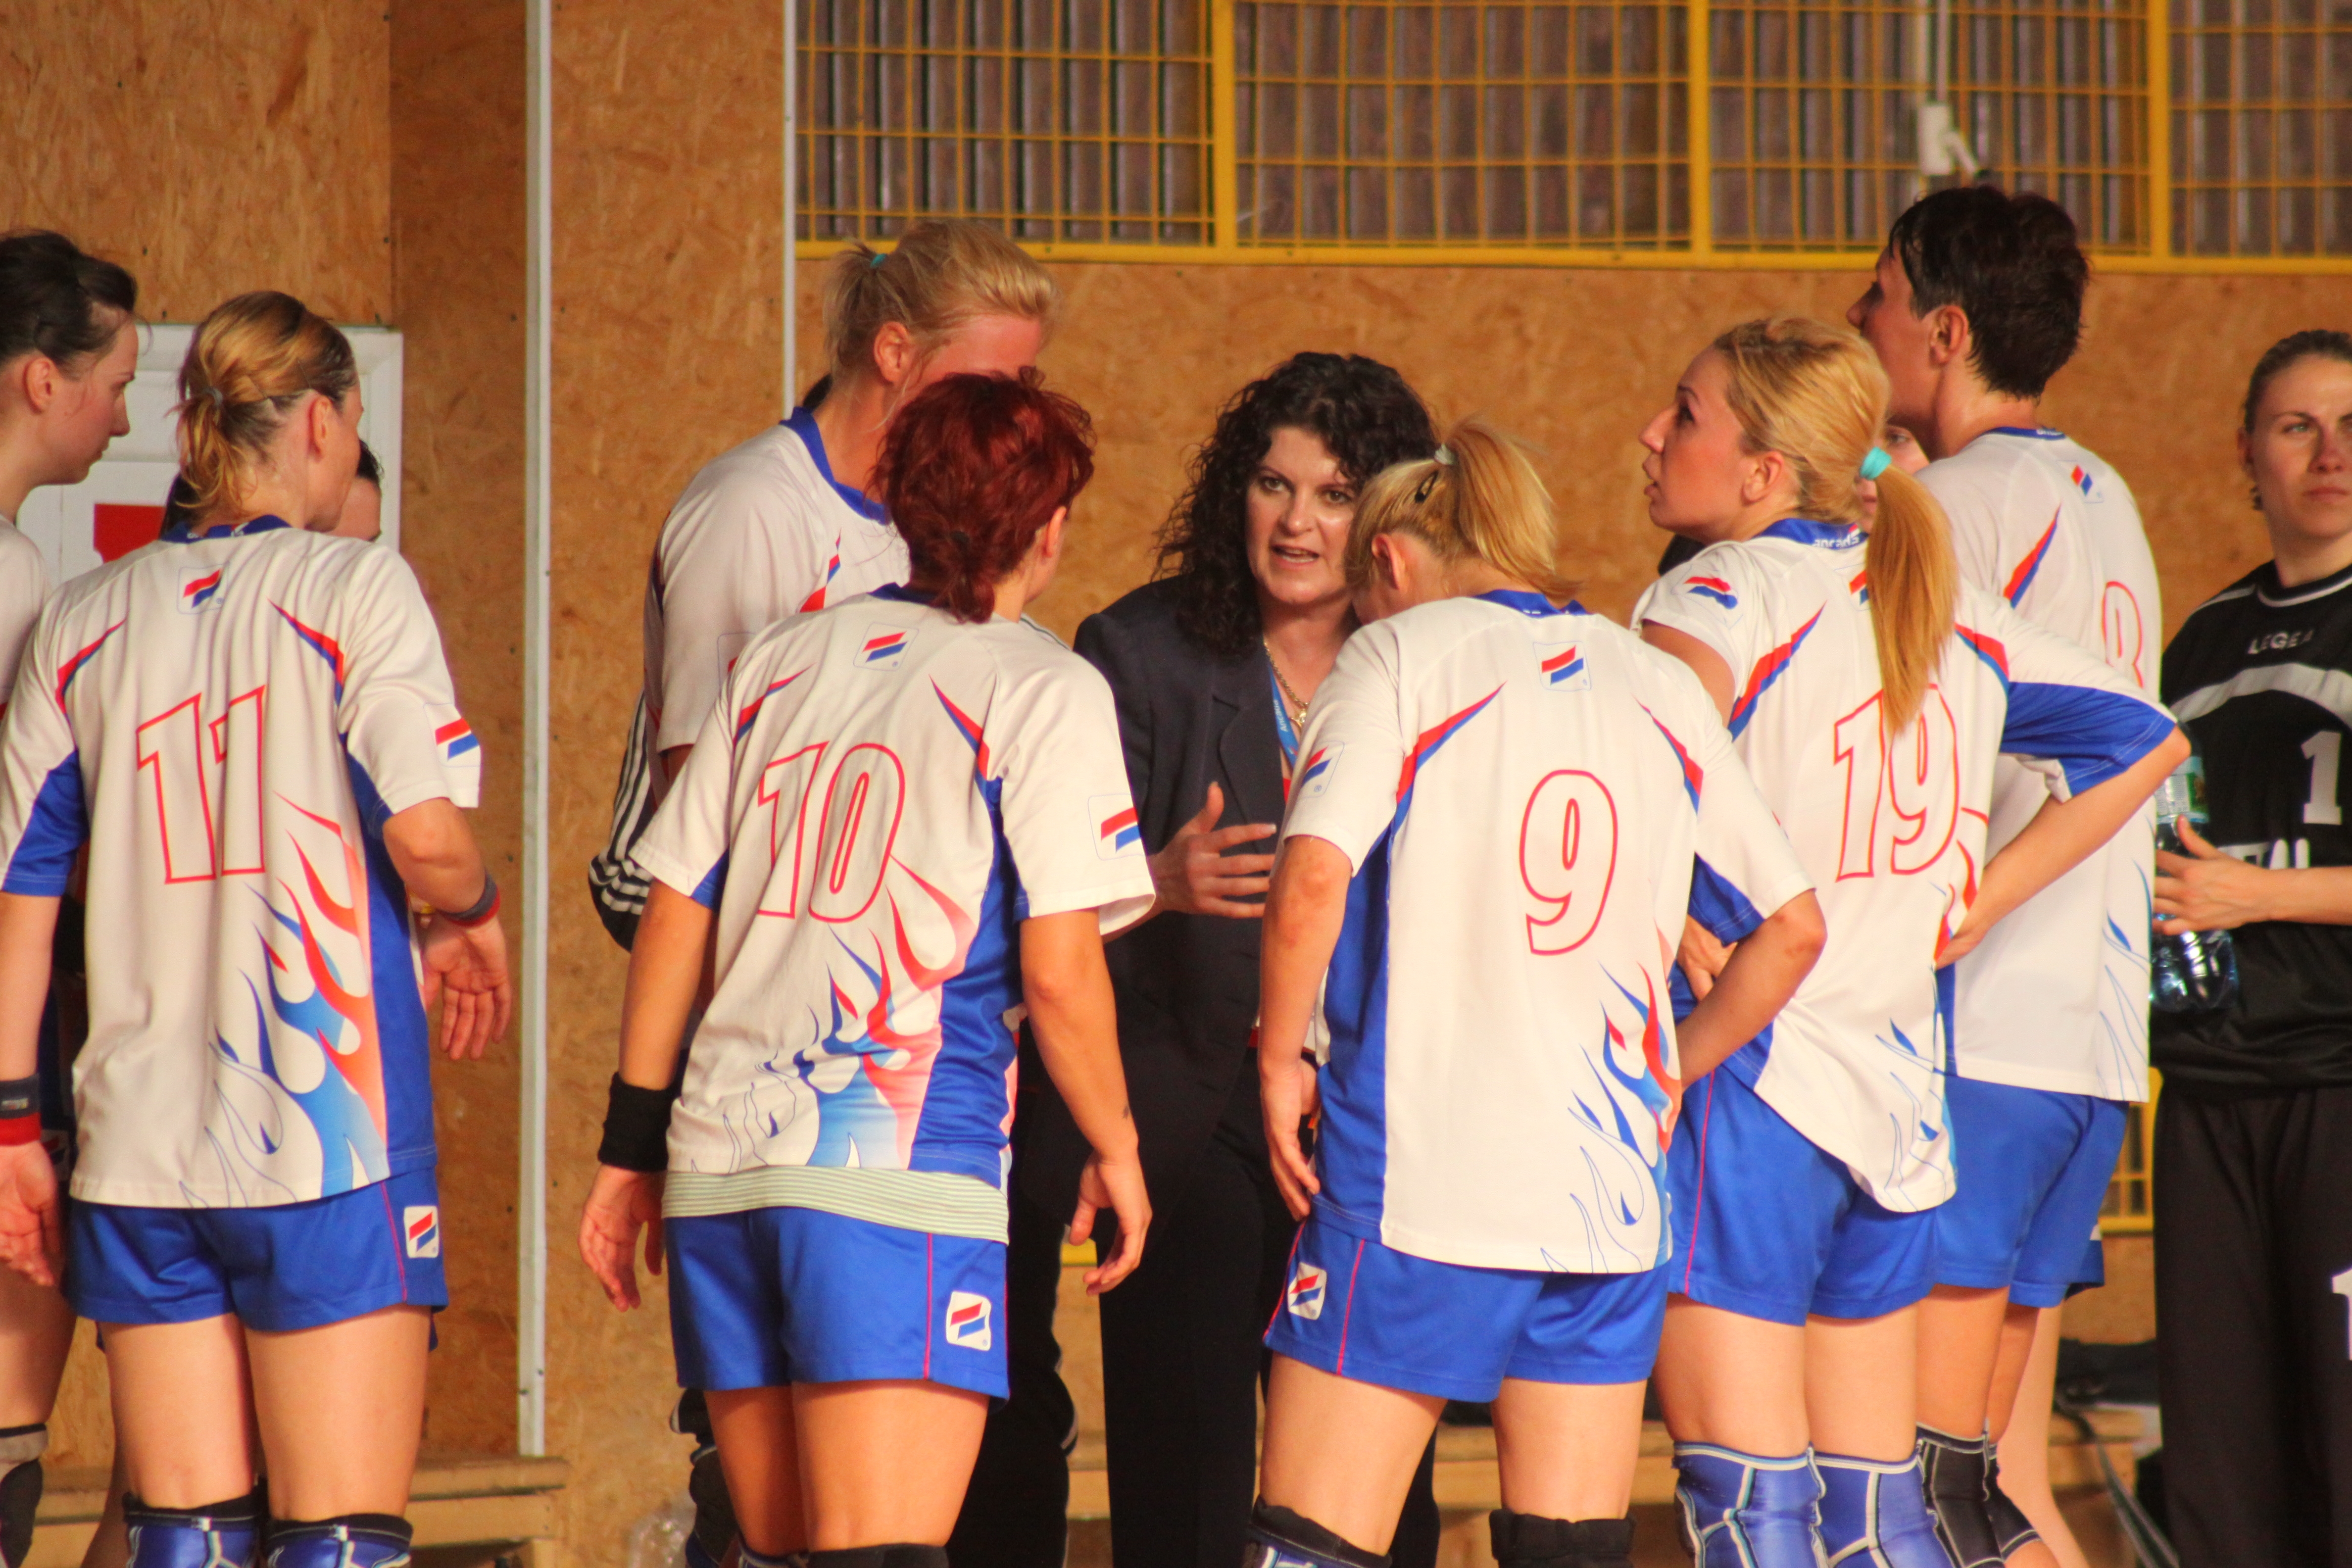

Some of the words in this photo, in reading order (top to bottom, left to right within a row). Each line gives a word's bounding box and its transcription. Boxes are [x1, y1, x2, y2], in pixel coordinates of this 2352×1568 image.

[136, 684, 266, 884] 11
[757, 740, 906, 924] 10
[1519, 769, 1618, 956] 9
[1833, 683, 1960, 883] 19
[2301, 731, 2343, 826] 1
